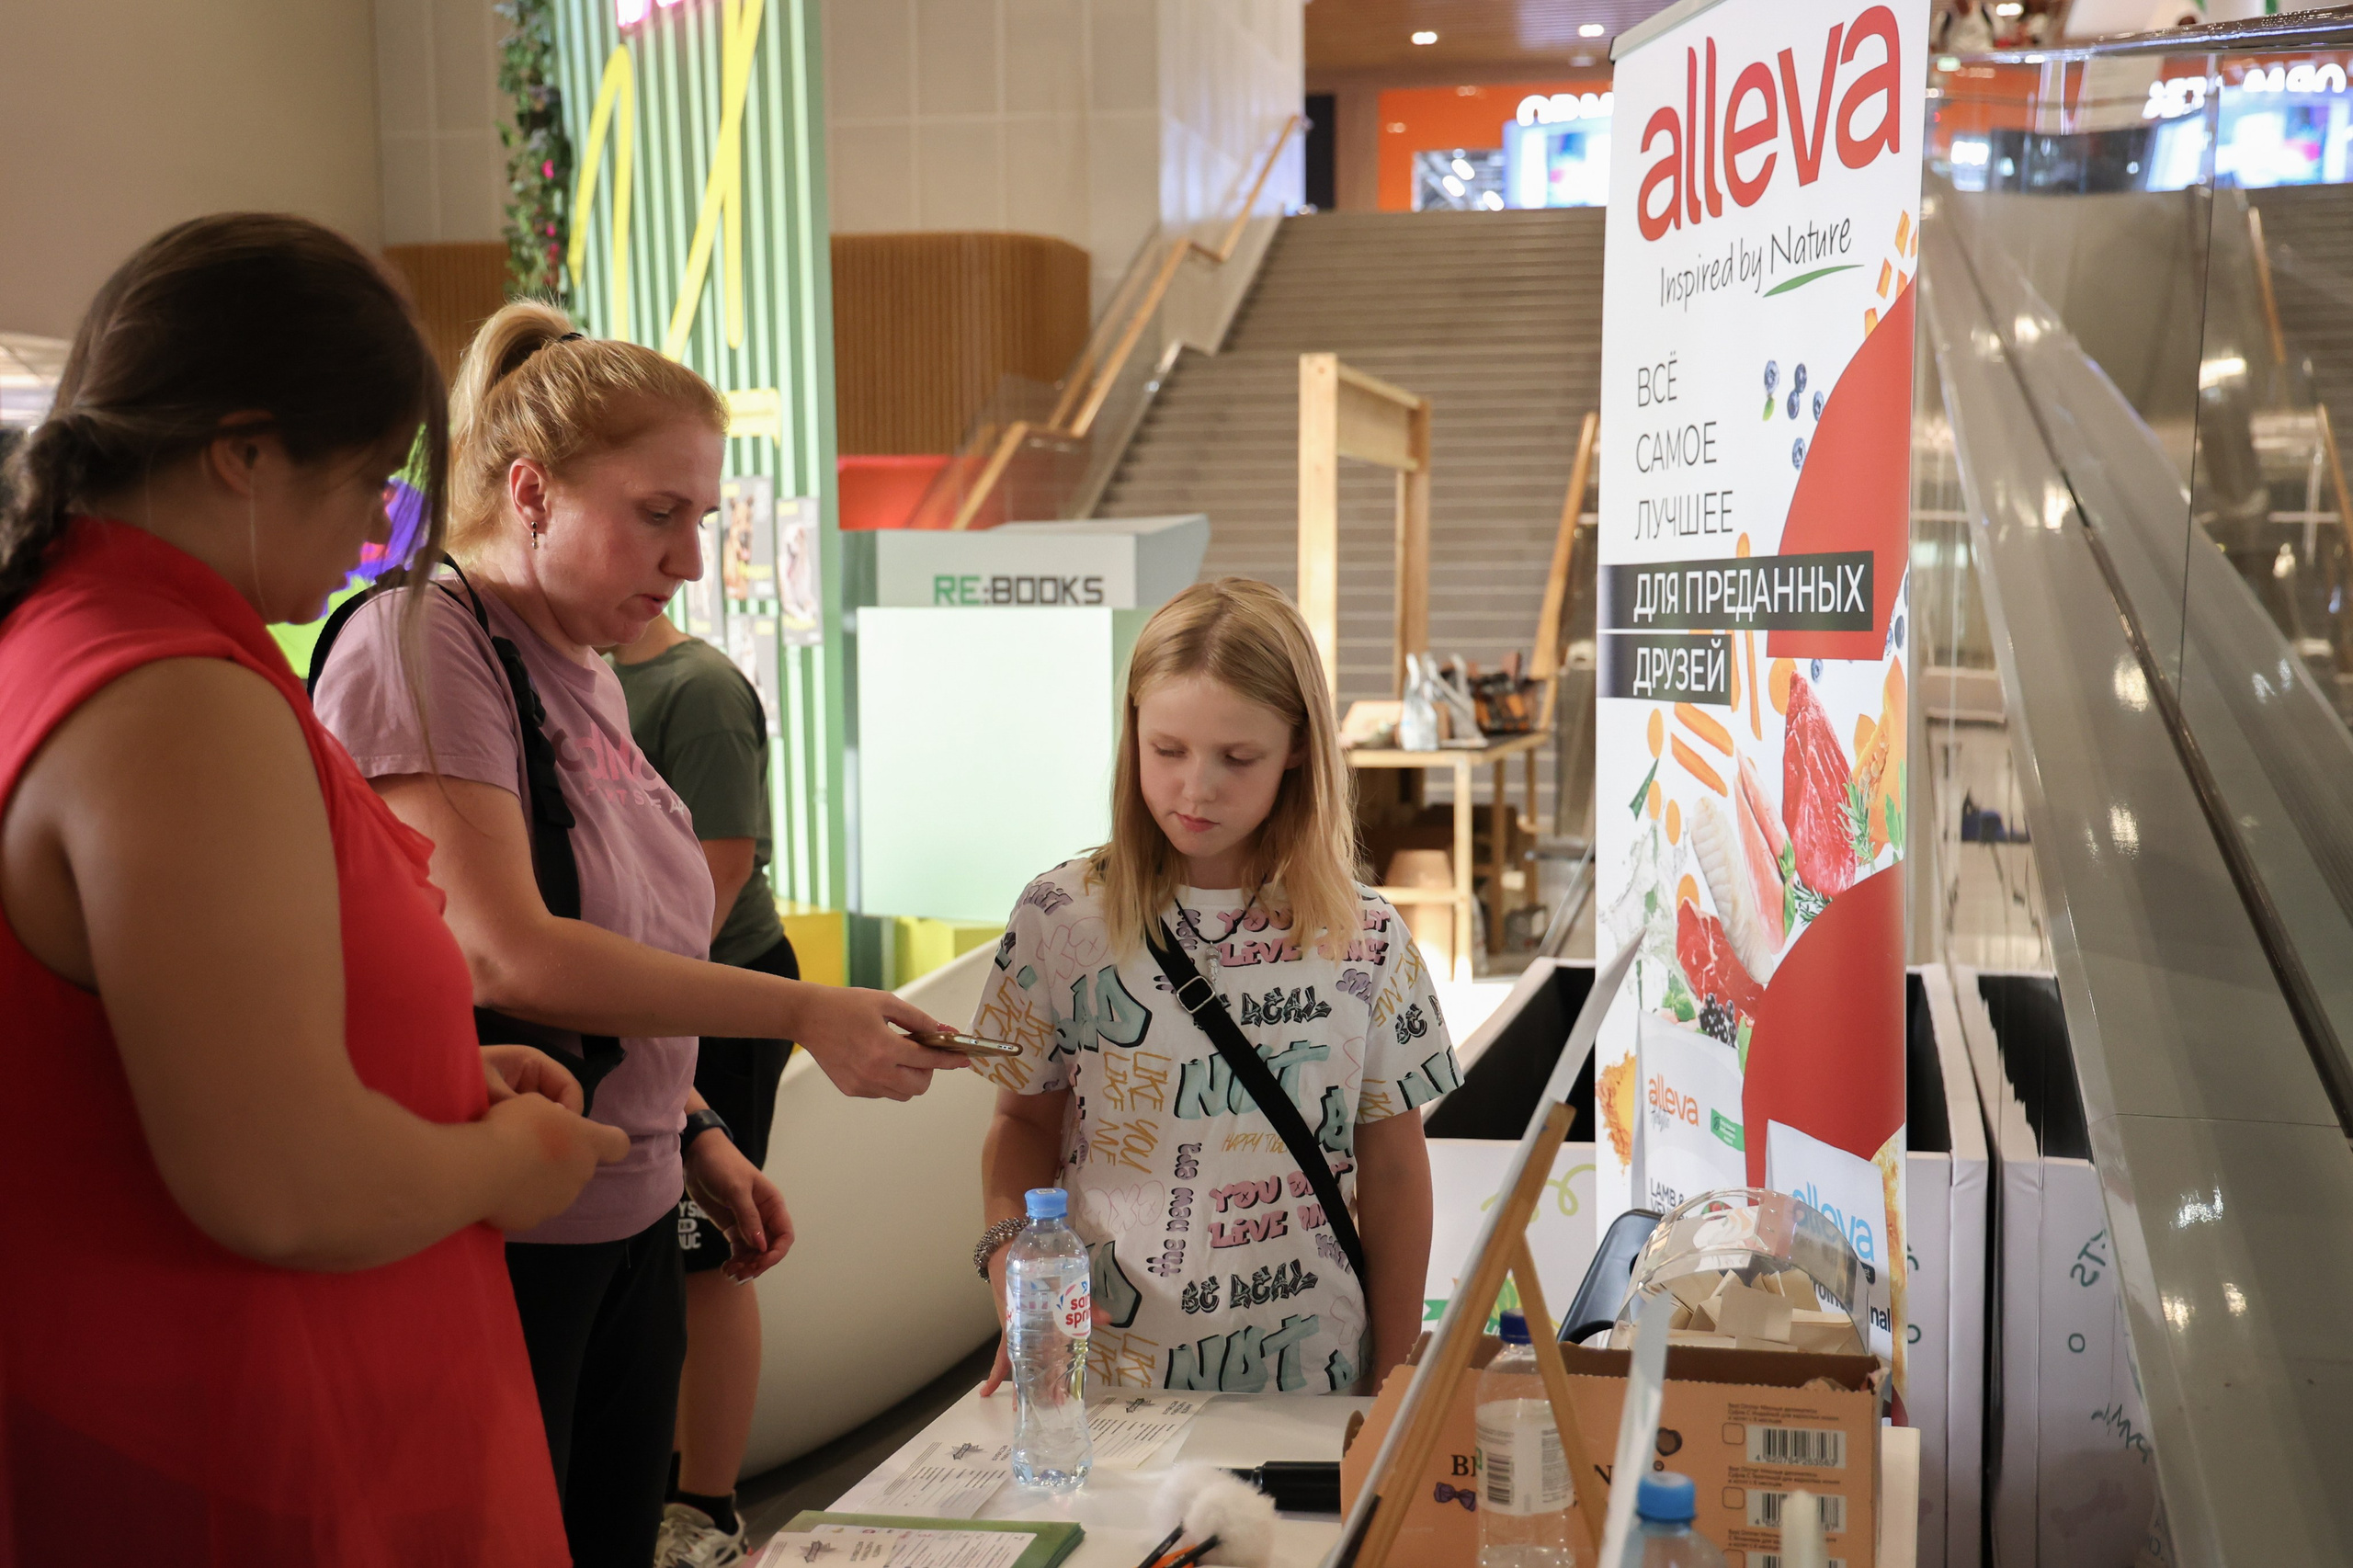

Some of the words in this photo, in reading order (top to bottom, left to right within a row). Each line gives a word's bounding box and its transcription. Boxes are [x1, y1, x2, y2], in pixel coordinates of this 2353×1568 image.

[1637, 6, 1901, 242] alleva
[1660, 242, 1733, 312] Inspired
[1740, 237, 1763, 294] by
[1770, 218, 1852, 275] Nature
[1637, 350, 1678, 407] ВСЁ
[1635, 420, 1718, 473] САМОЕ
[1634, 490, 1733, 540] ЛУЧШЕЕ
[933, 574, 1104, 607] RE:BOOKS
[1633, 571, 1680, 623] ДЛЯ
[1684, 563, 1866, 623] ПРЕДАННЫХ
[1632, 637, 1725, 697] ДРУЗЕЙ
[1649, 1073, 1699, 1127] alleva
[1221, 1131, 1264, 1153] HAPPY
[1165, 1187, 1194, 1233] new
[1209, 1175, 1281, 1213] YOU
[1650, 1177, 1677, 1208] LAMB
[1145, 1238, 1187, 1278] the
[1164, 1313, 1321, 1392] NOT
